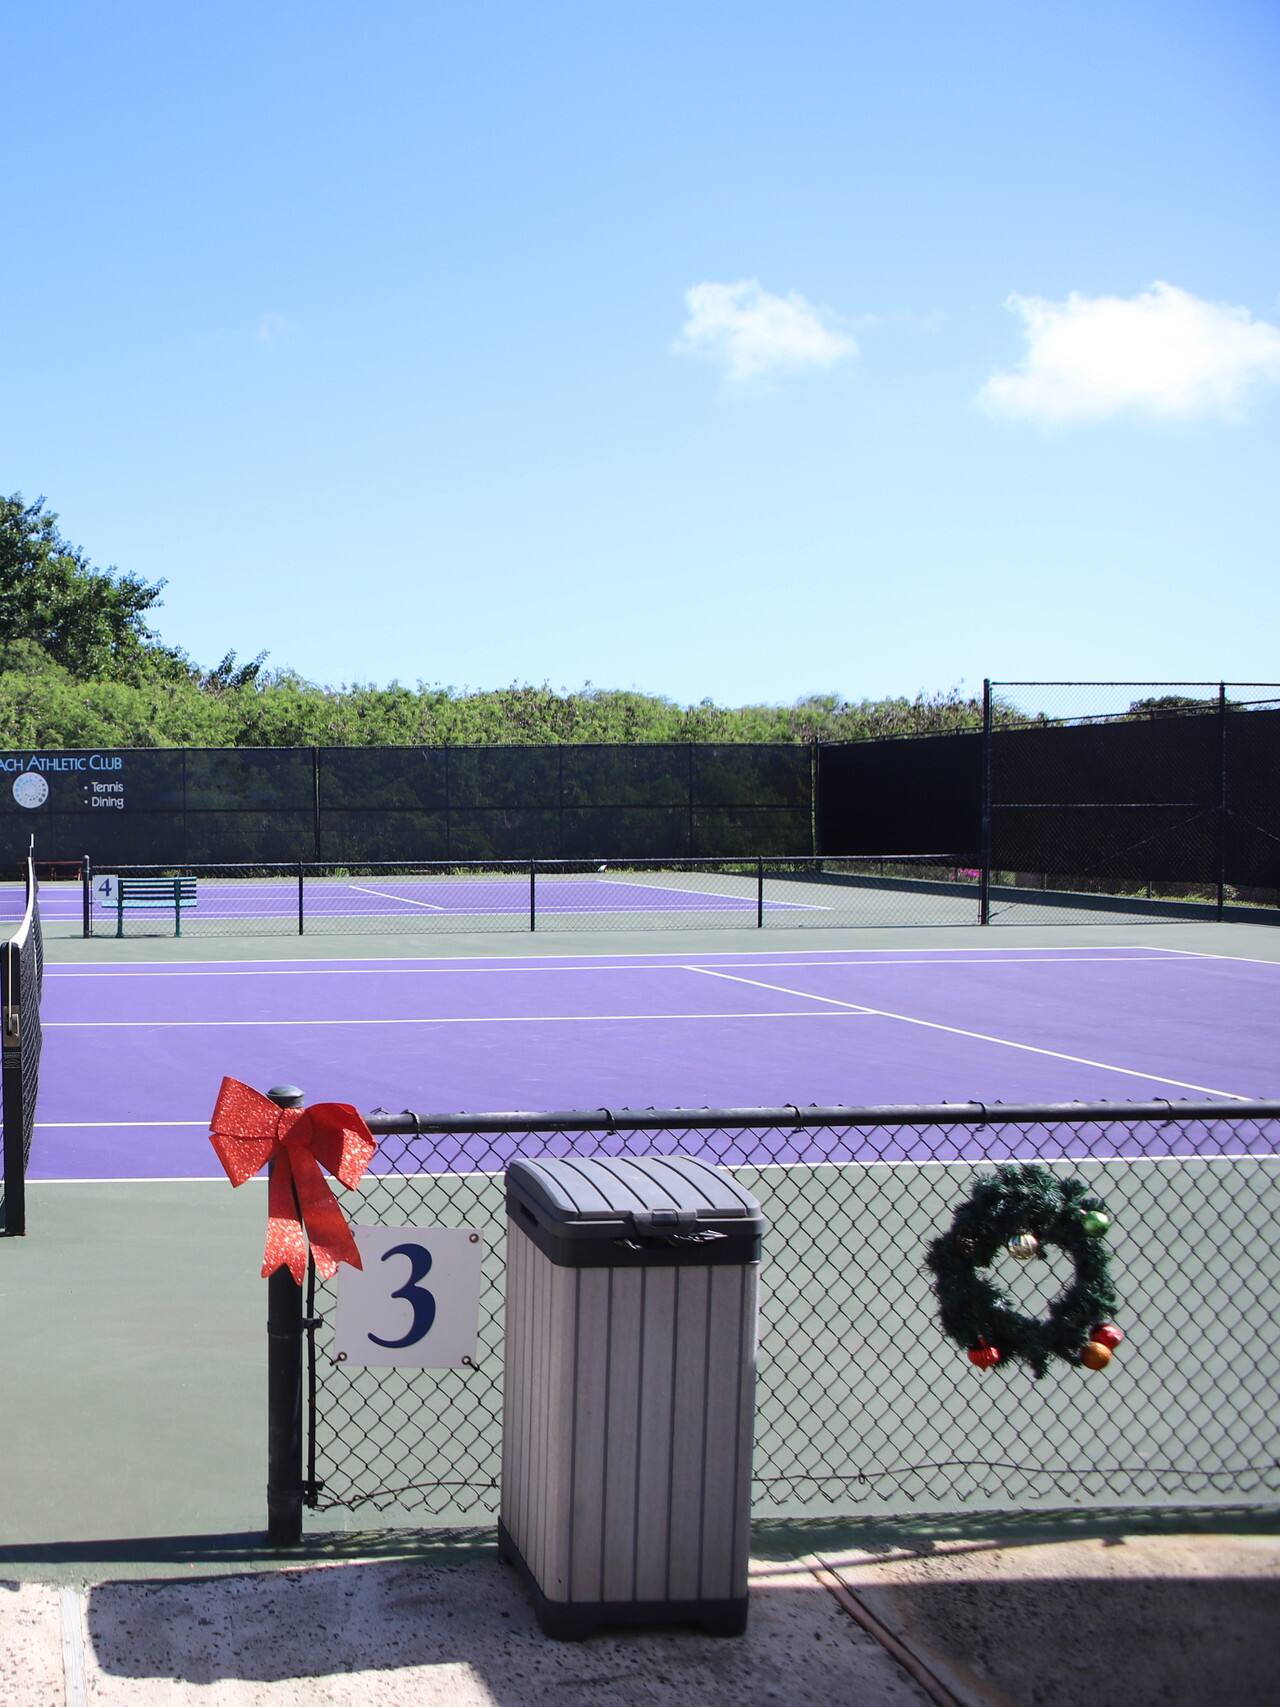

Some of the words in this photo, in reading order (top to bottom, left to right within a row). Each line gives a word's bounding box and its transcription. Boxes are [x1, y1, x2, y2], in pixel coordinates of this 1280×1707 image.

[26, 755, 86, 771] ATHLETIC
[89, 754, 122, 771] CLUB
[92, 781, 124, 793] Tennis
[91, 796, 124, 809] Dining
[98, 878, 112, 897] 4
[367, 1243, 436, 1349] 3
